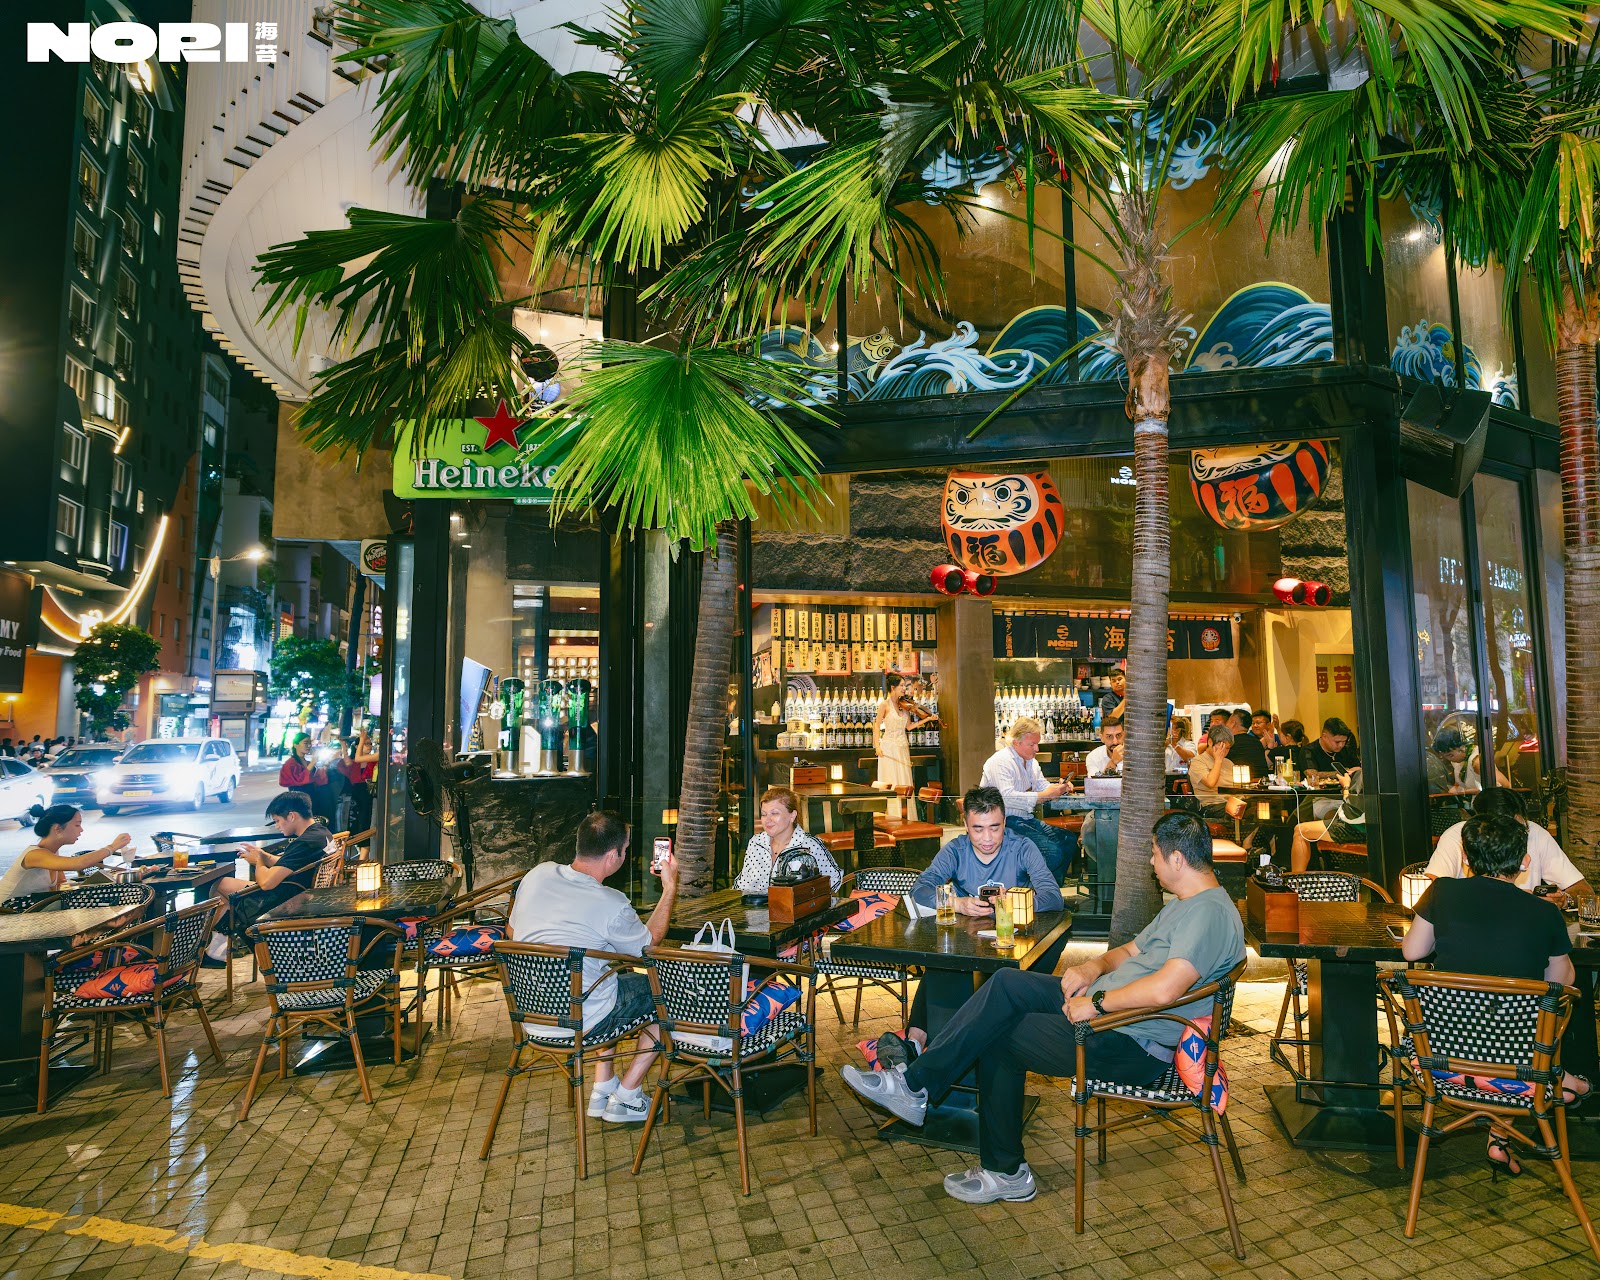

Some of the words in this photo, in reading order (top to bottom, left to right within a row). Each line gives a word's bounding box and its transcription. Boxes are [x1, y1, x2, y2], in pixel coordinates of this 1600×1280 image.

[461, 444, 477, 452] EST.
[412, 458, 572, 488] Heineke
[1110, 477, 1137, 486] NOR
[1047, 639, 1078, 648] NORI
